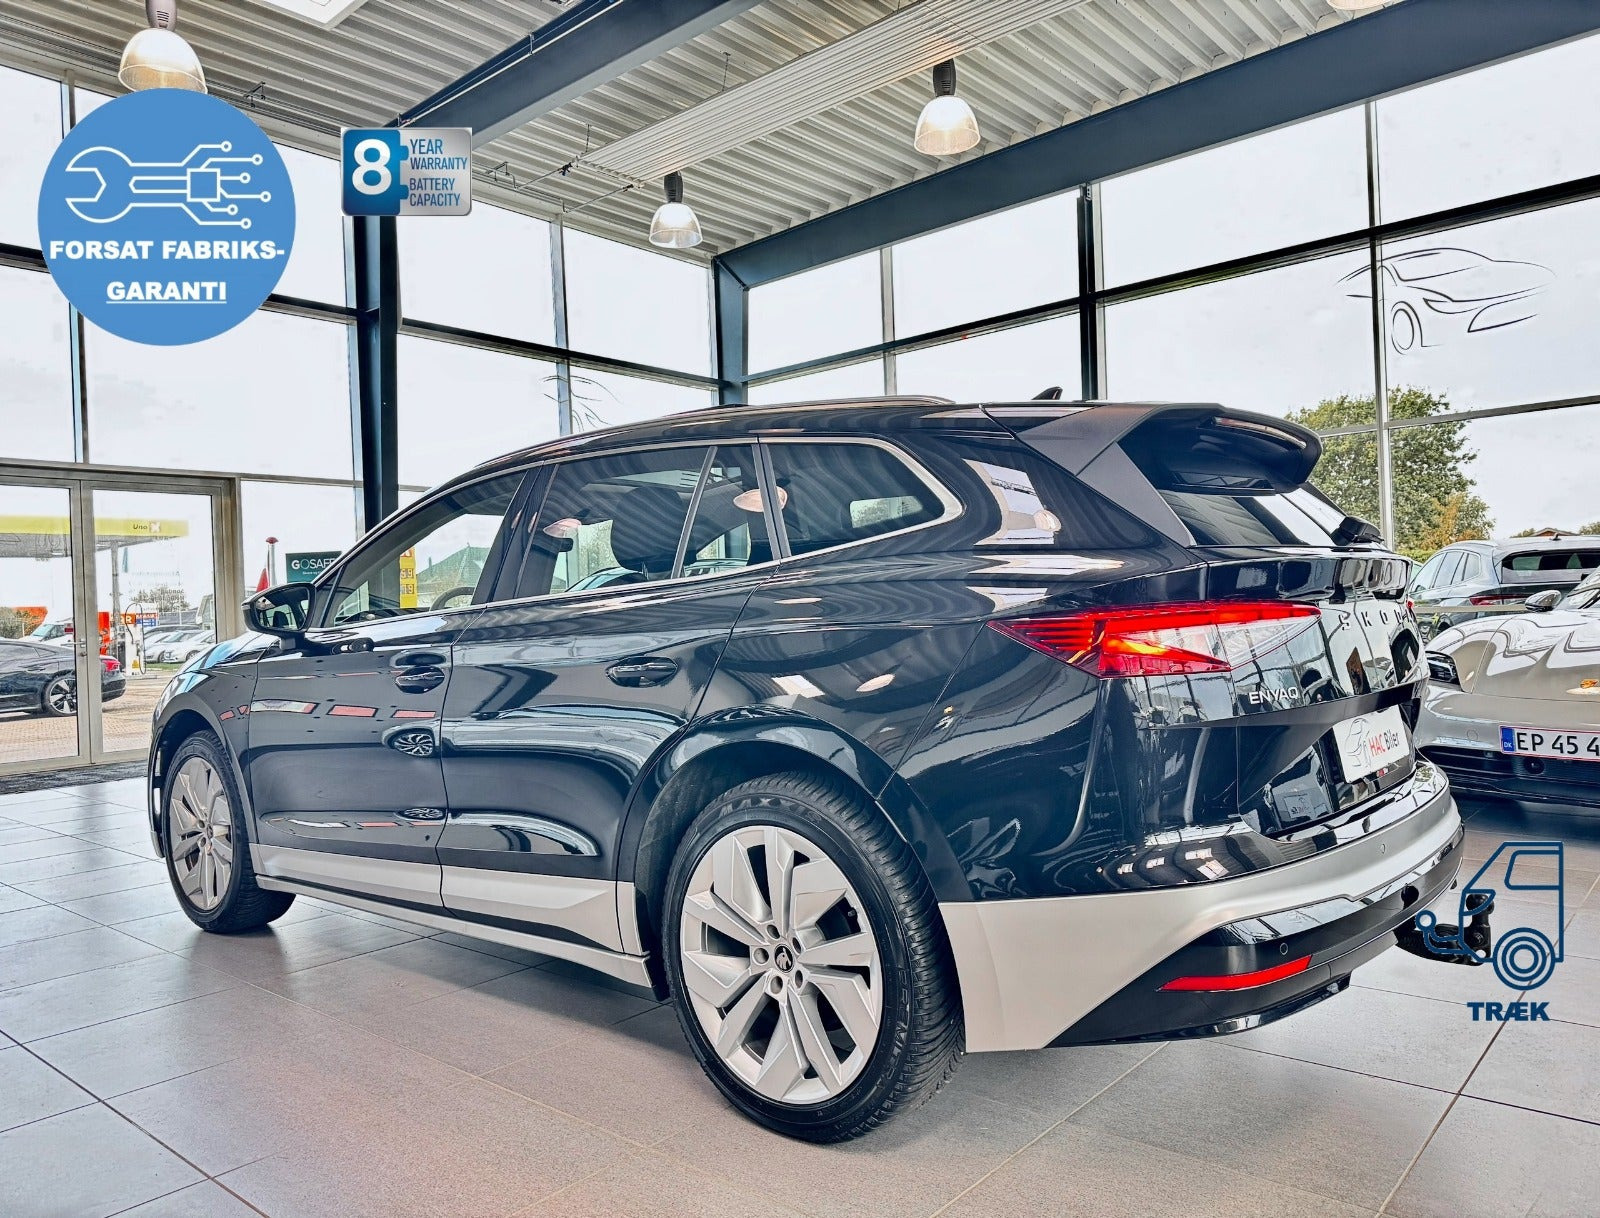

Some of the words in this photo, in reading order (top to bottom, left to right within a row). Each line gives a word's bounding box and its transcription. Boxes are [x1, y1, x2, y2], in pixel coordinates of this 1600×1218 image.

[1249, 686, 1299, 705] ENYAQ
[1368, 731, 1386, 757] HAC
[1384, 728, 1400, 750] Biler
[1516, 732, 1545, 752] EP
[1551, 735, 1579, 755] 45
[1586, 737, 1600, 757] 4
